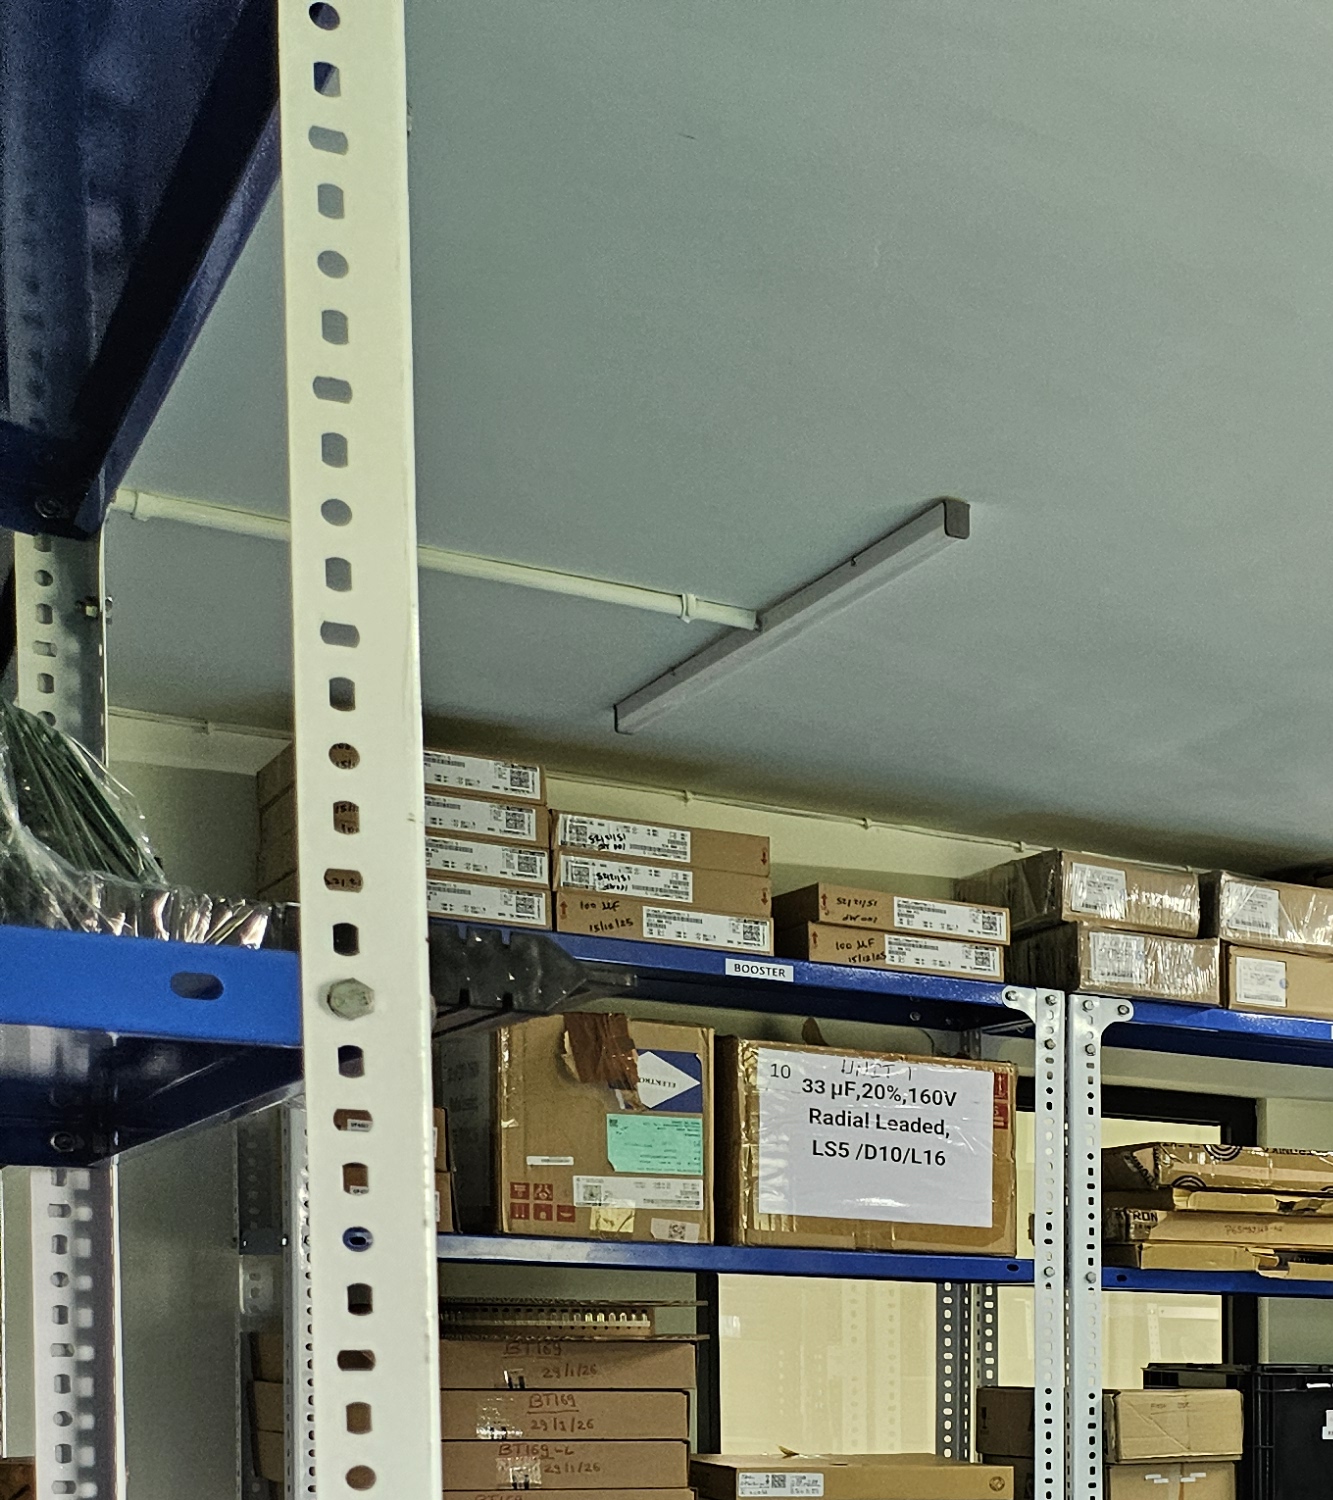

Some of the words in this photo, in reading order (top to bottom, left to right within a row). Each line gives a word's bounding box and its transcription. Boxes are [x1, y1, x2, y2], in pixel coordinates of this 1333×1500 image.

[734, 963, 785, 978] BOOSTER
[770, 1063, 791, 1079] 10
[802, 1079, 826, 1094] 33
[809, 1108, 870, 1129] Radial
[876, 1114, 950, 1139] Leaded,
[812, 1140, 850, 1158] LS5
[855, 1144, 946, 1166] /D10/L16
